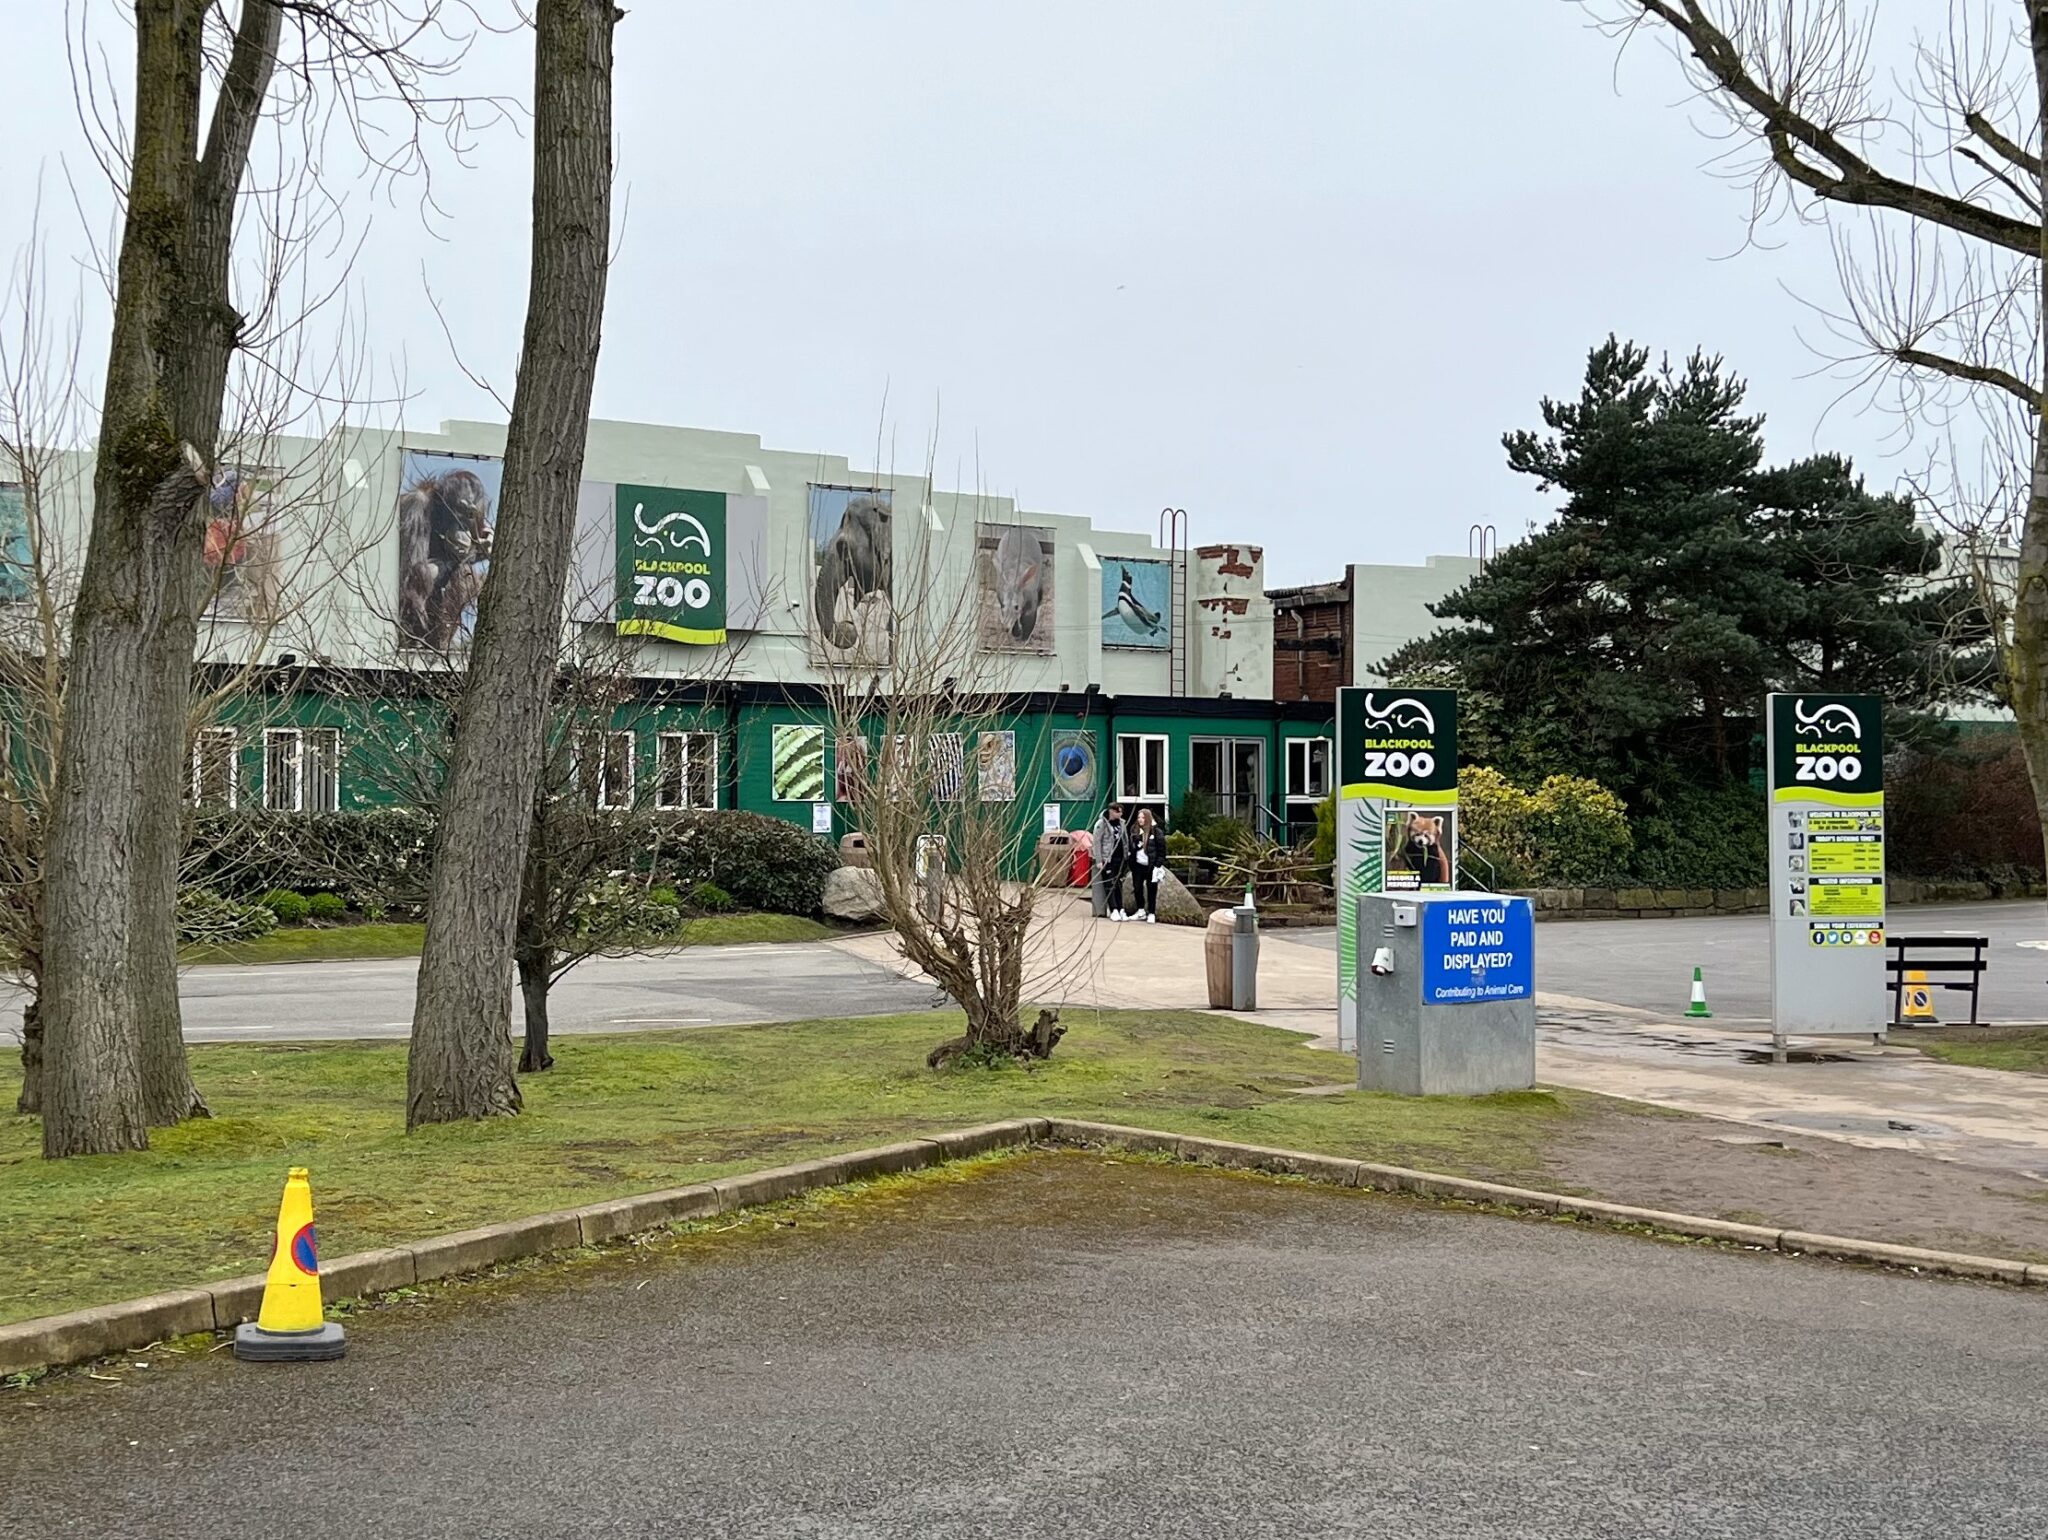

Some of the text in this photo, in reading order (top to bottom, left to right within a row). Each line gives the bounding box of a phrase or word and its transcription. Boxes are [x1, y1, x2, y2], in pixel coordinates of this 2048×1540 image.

[635, 559, 711, 575] BLACKPOOL
[633, 575, 711, 609] ZOO
[1364, 739, 1434, 749] BLACKPOOL
[1795, 744, 1861, 753] BLACKPOOL
[1364, 752, 1435, 777] ZOO
[1795, 756, 1862, 781] ZOO
[1448, 908, 1506, 925] HAVE YOU
[1450, 930, 1504, 947] PAID AND
[1443, 952, 1513, 970] DISPLAYED?
[1435, 984, 1524, 999] Contributing to Animal Care
